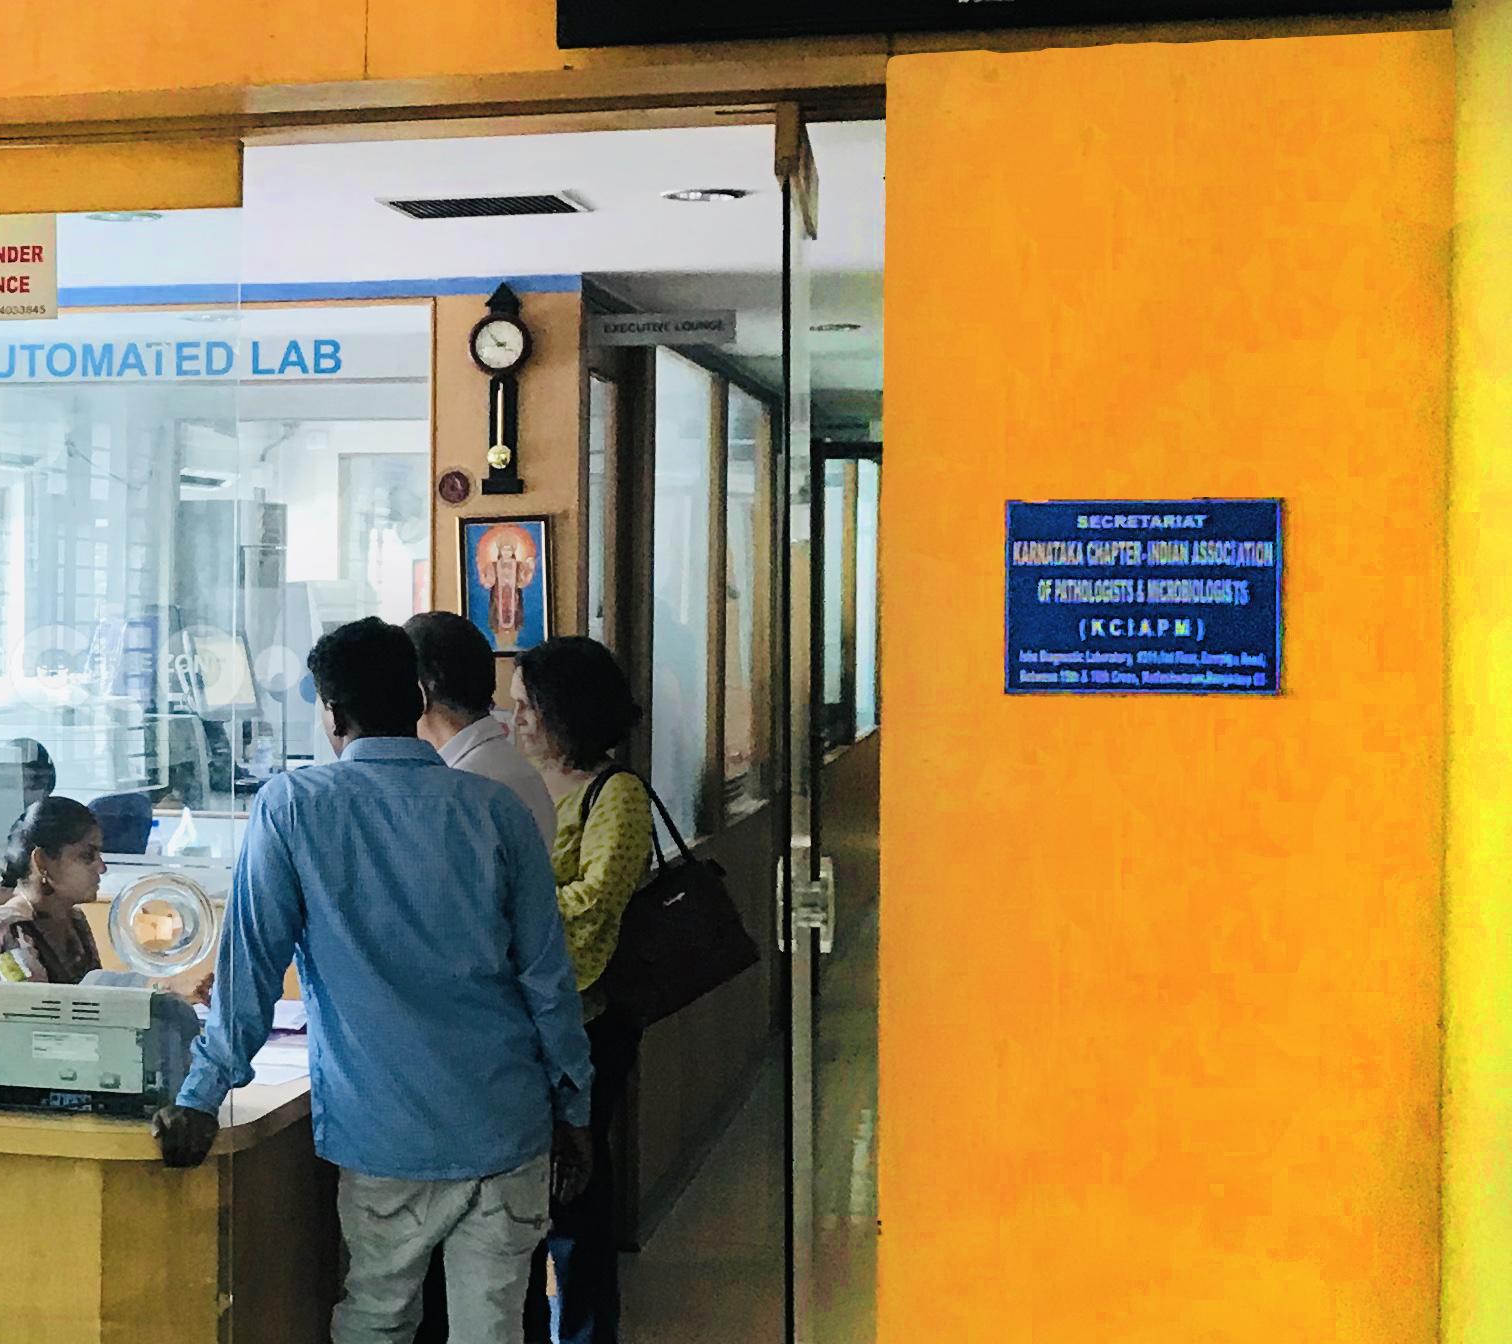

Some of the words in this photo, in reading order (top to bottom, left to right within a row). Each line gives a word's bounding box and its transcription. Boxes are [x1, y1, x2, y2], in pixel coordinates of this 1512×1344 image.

[603, 321, 670, 334] EXECUTIVE
[675, 319, 725, 332] LOUNGE
[253, 338, 343, 375] LAB
[1077, 514, 1208, 529] SECRETARIAT
[1191, 540, 1274, 567] ASSOCIATION
[1038, 579, 1053, 603] OF
